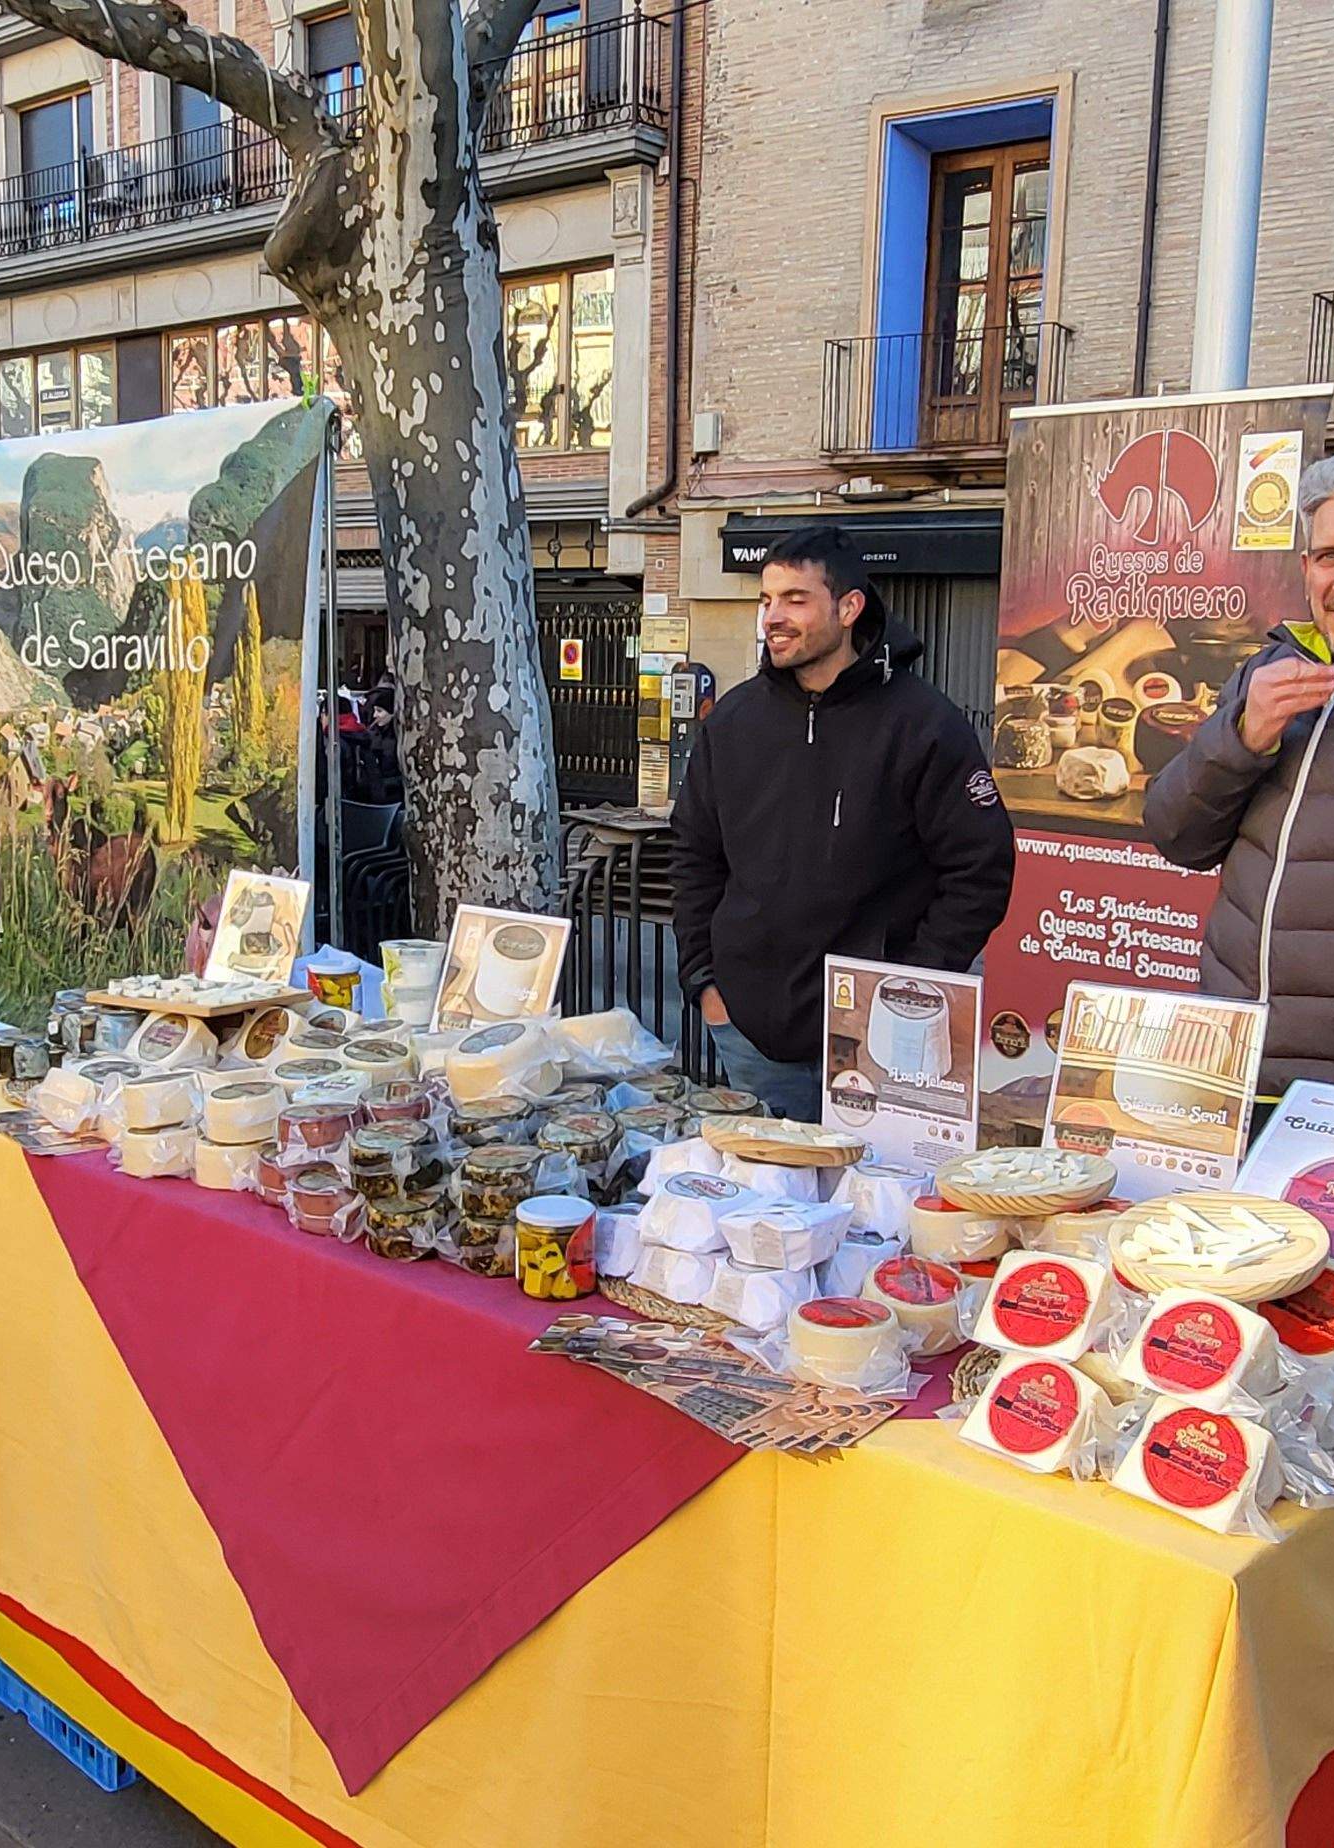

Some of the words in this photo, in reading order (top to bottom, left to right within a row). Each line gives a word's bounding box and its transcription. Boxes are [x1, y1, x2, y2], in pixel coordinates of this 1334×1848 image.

[89, 533, 257, 585] Artesano
[1090, 543, 1168, 583] Quesos
[1174, 541, 1204, 573] de
[1066, 572, 1246, 633] Radiquero
[20, 601, 62, 668] de
[68, 598, 210, 673] Saravillo
[701, 675, 711, 693] P
[1039, 909, 1107, 940] Quesos
[1059, 889, 1095, 915] Los
[1096, 896, 1199, 930] Auténticos
[1020, 934, 1040, 955] de
[1043, 939, 1101, 966] Cabra
[1105, 948, 1131, 971] del
[889, 1067, 913, 1083] Los
[1167, 1103, 1186, 1118] de
[1189, 1106, 1227, 1125] Sevil
